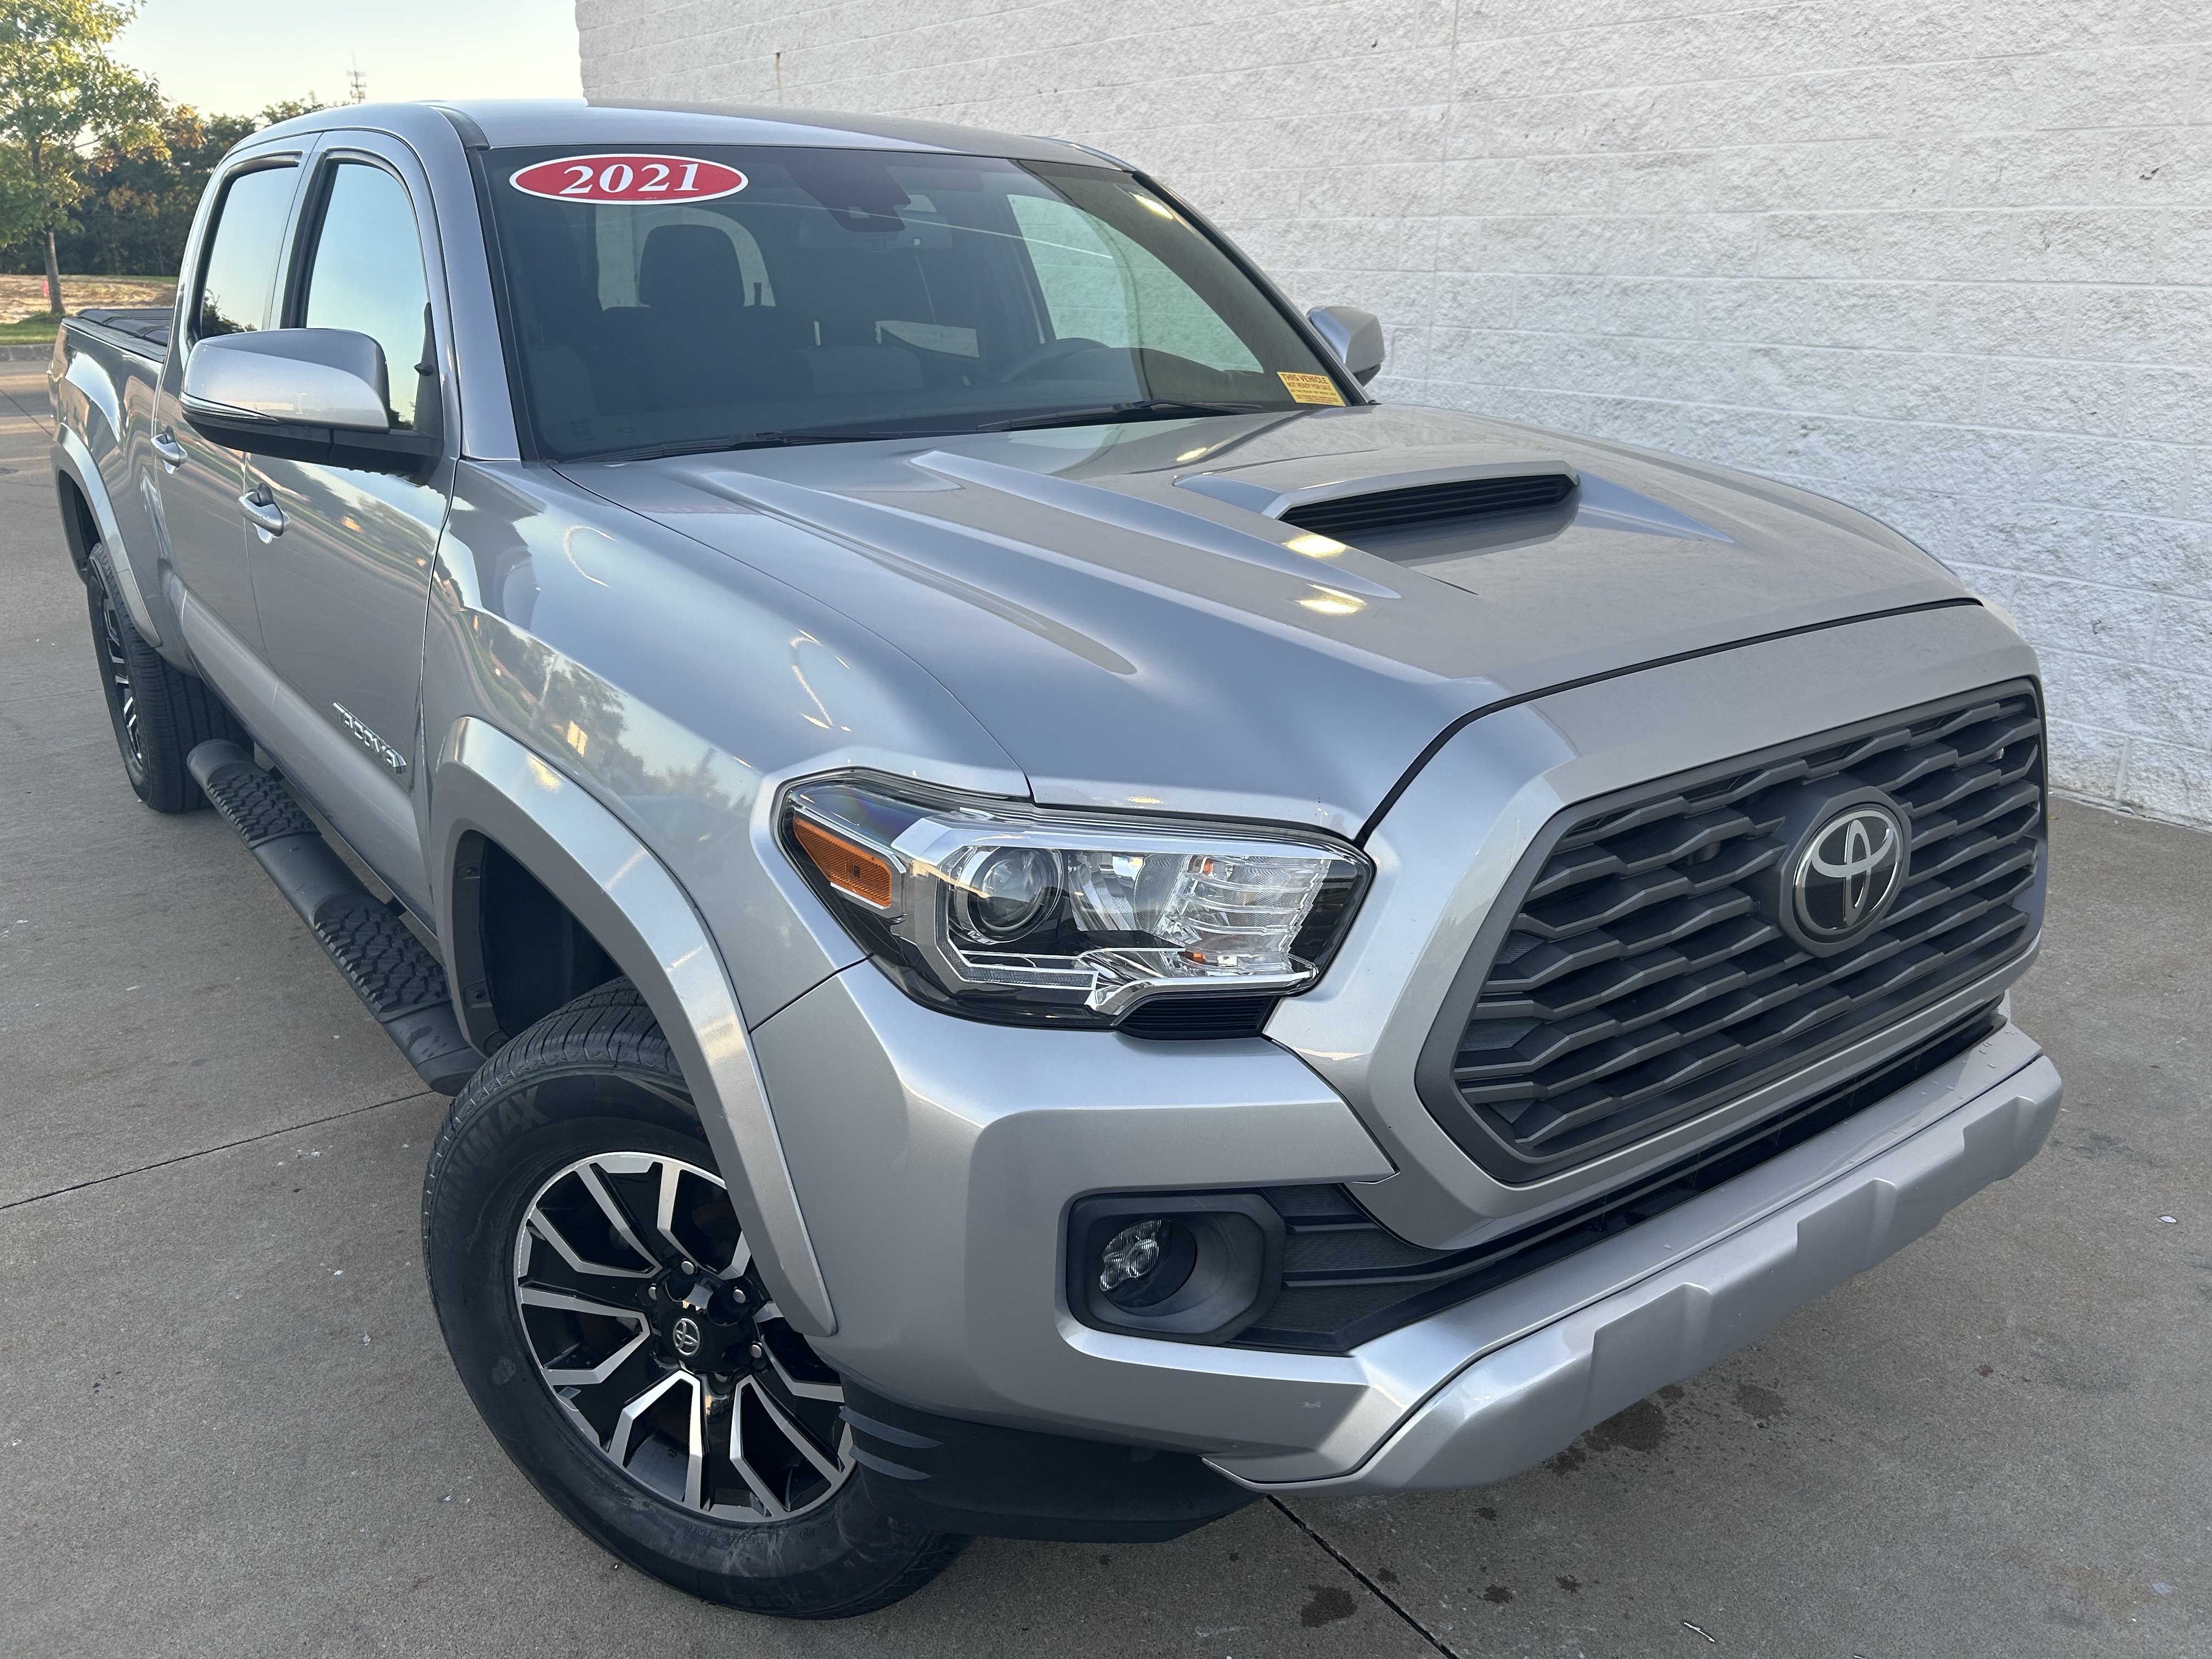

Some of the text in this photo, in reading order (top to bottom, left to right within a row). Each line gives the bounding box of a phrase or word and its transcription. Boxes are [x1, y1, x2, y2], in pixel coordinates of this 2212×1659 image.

[558, 163, 700, 195] 2021
[1298, 375, 1329, 384] VEHICLE
[333, 702, 407, 774] TACOMA
